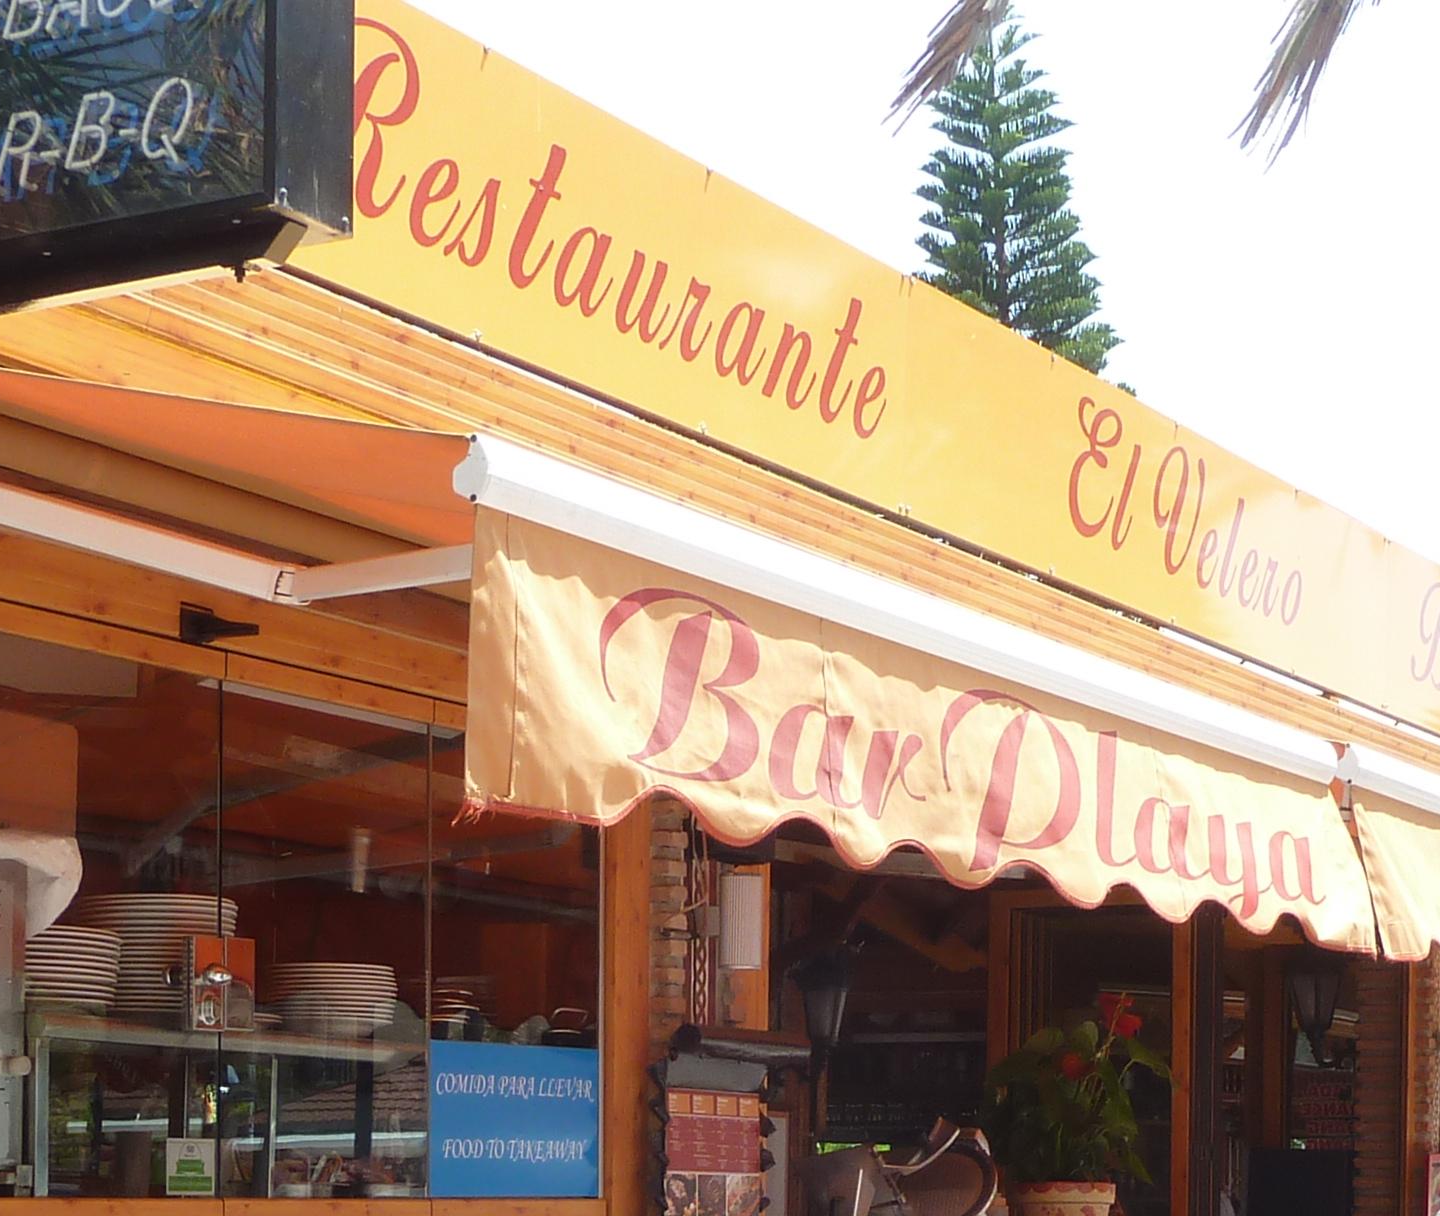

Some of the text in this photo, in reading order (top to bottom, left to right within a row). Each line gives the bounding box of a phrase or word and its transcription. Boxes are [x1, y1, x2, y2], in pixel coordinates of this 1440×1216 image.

[354, 17, 888, 439] Restaurante
[1068, 396, 1304, 626] El Velero
[599, 588, 1327, 917] Bar Playa
[435, 1072, 595, 1103] COMIDA PARA LLEVAR
[442, 1136, 589, 1164] FOOD TO TAKEAWAY
